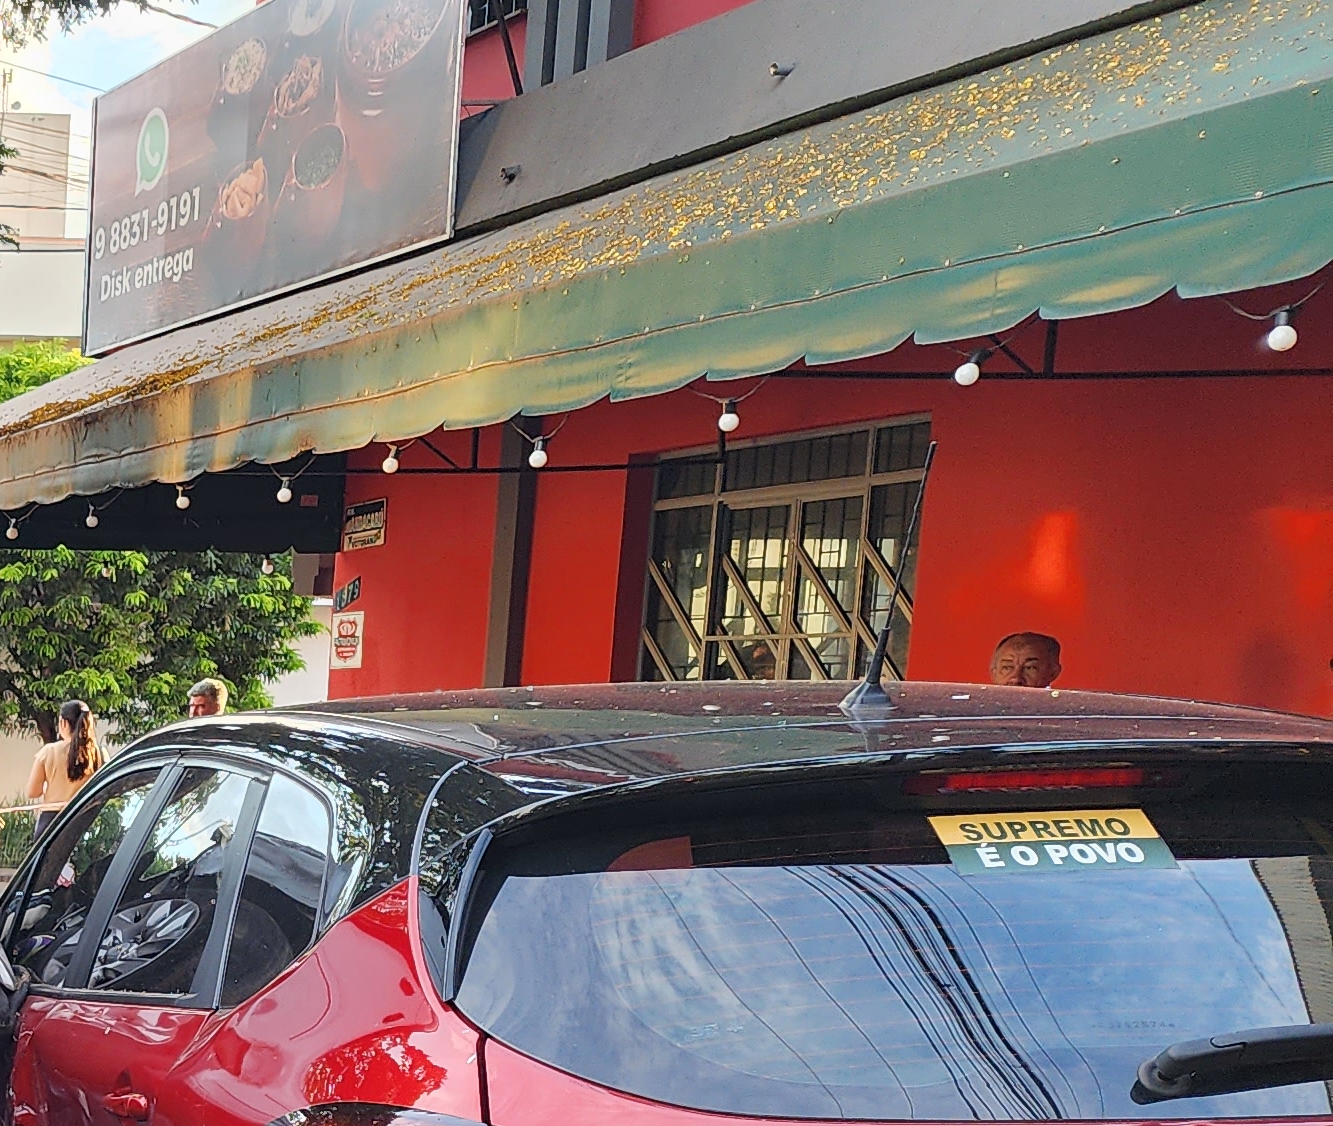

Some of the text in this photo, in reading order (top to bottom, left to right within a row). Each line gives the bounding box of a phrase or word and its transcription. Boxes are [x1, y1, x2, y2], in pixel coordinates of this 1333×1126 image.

[95, 186, 201, 260] 9 8831-9191
[100, 247, 194, 302] Disk entrega
[959, 817, 1131, 842] SUPREMO
[975, 842, 1145, 868] É O POVO
